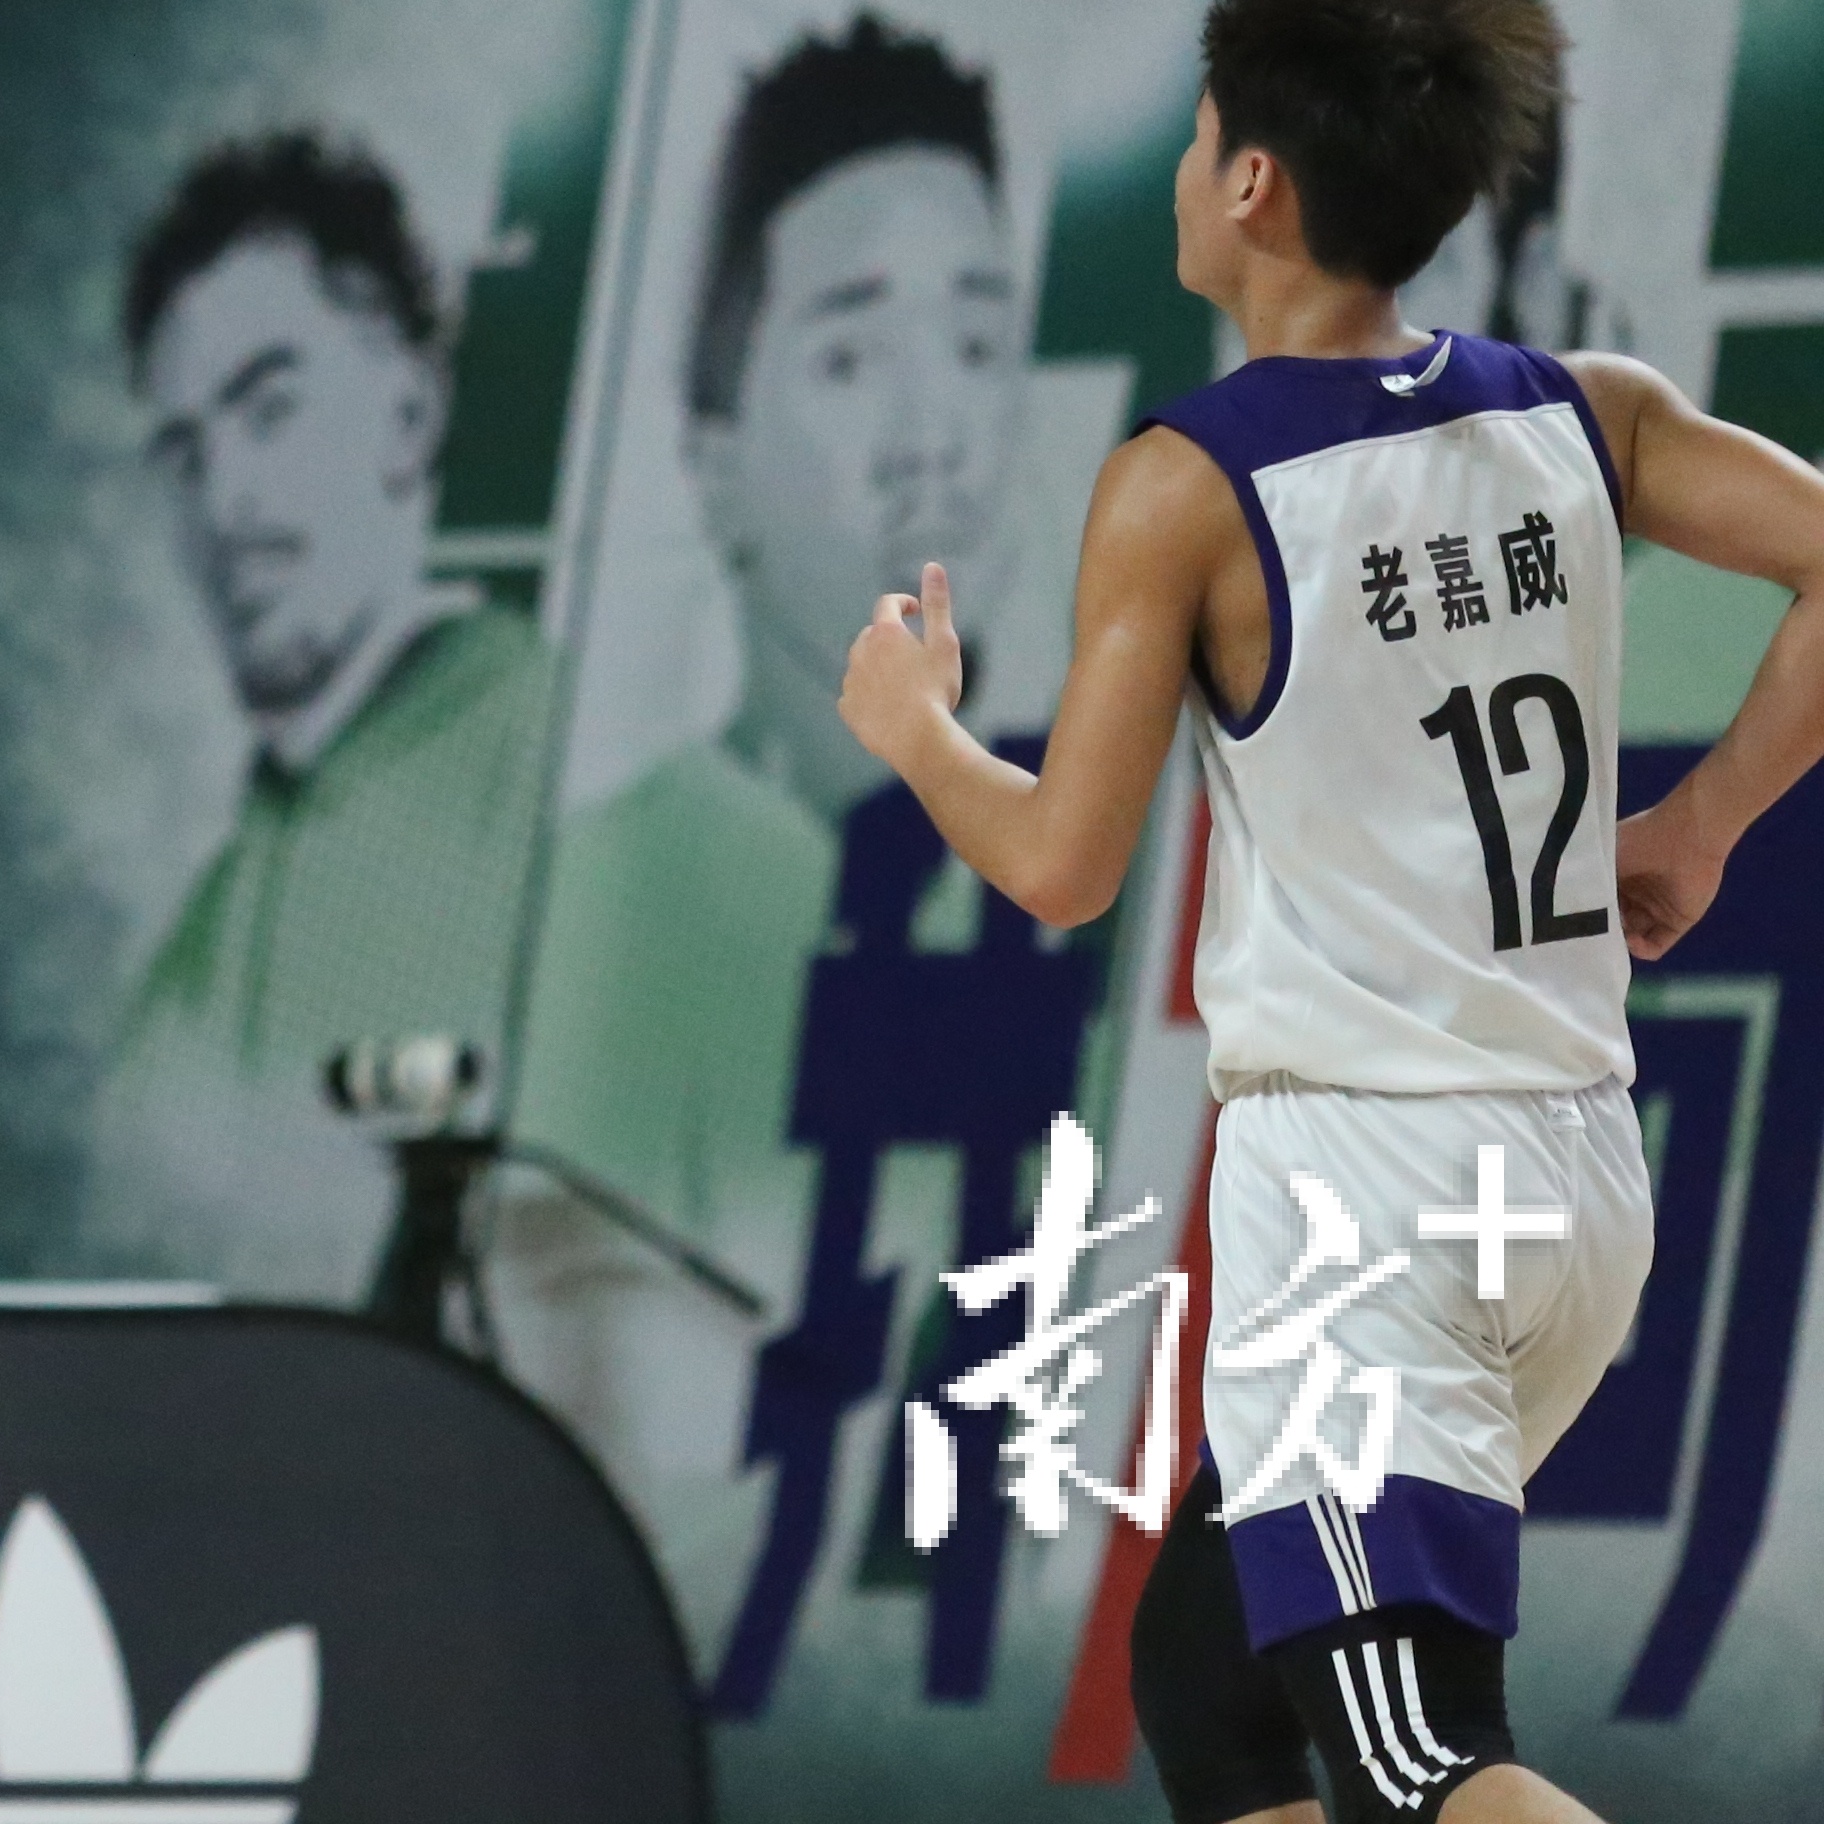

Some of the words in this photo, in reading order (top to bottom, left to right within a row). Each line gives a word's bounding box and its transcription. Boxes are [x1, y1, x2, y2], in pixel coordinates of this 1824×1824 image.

[1361, 511, 1568, 643] 老嘉威
[1419, 673, 1608, 953] 12
